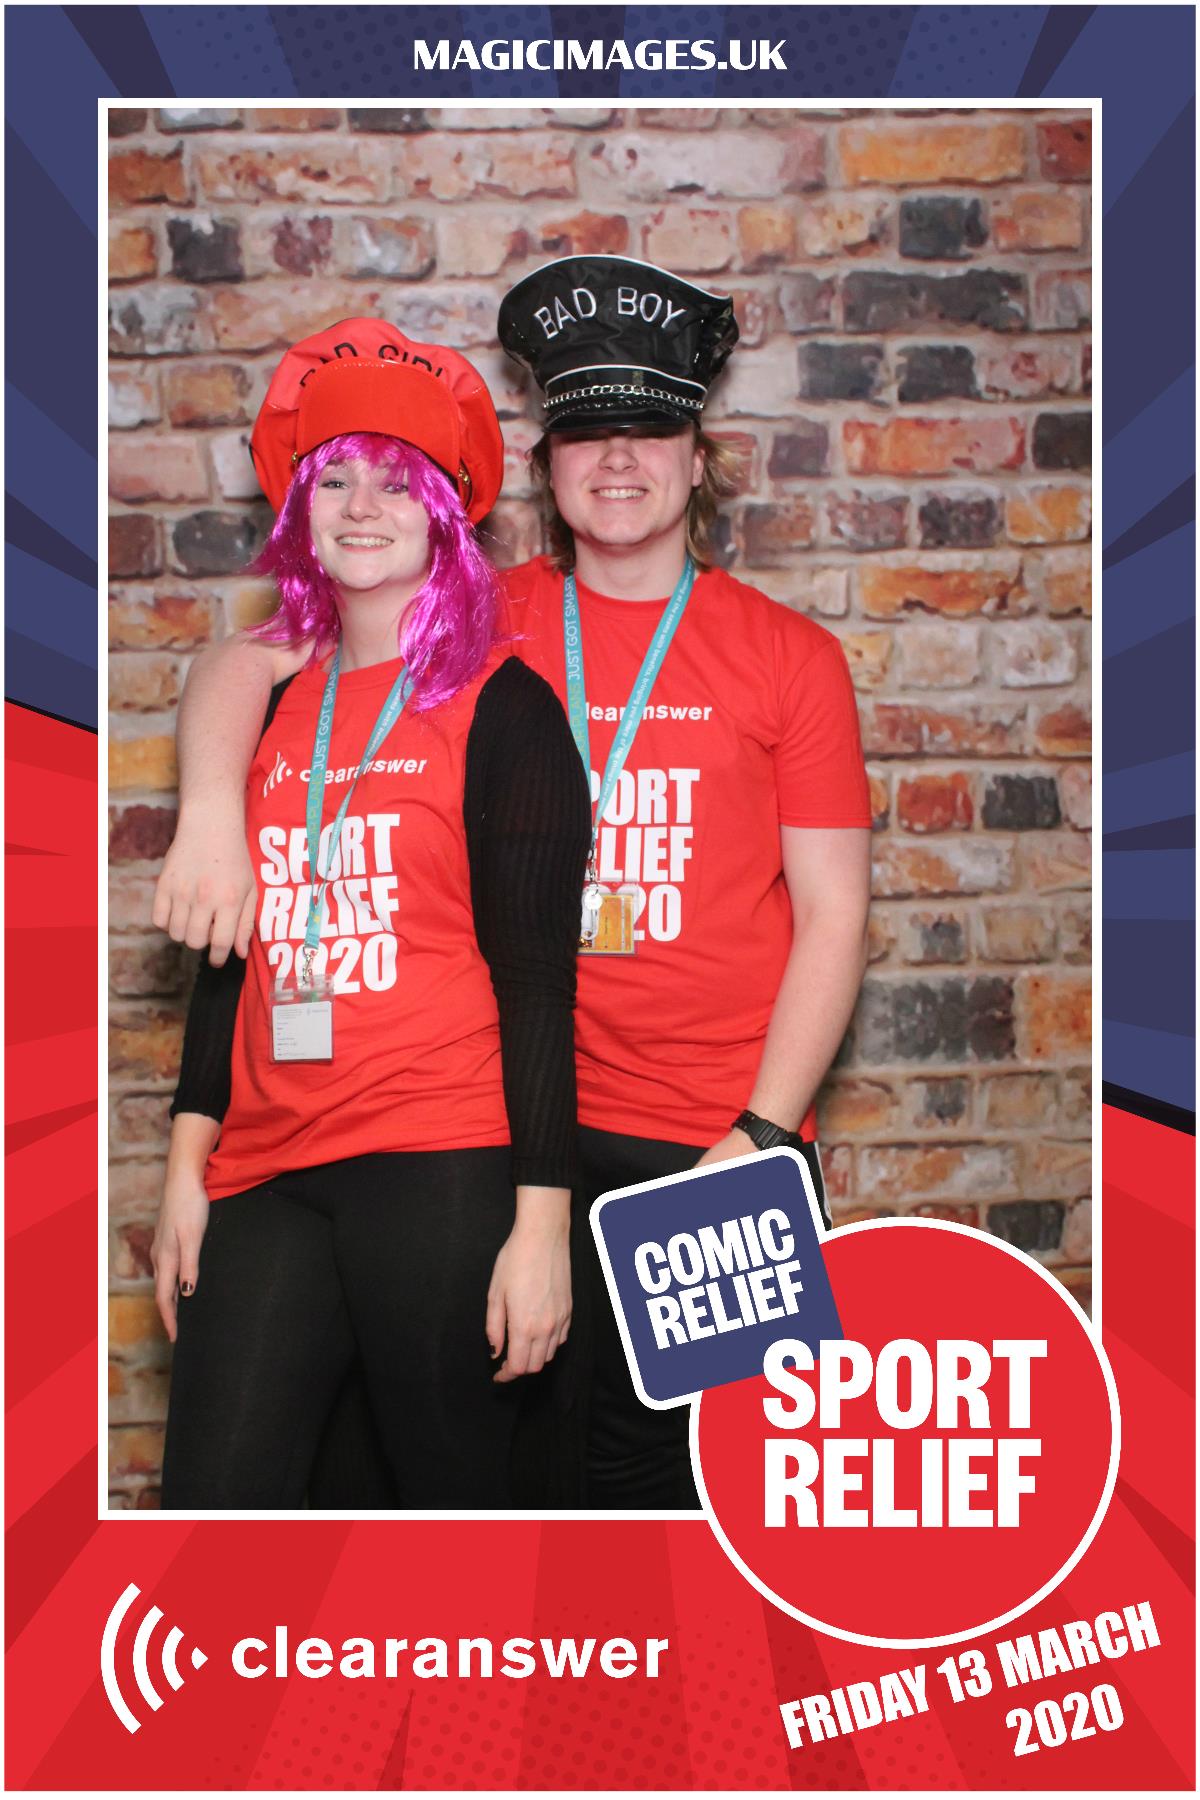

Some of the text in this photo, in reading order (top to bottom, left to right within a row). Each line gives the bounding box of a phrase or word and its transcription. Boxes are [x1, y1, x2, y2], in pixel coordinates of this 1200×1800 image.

[534, 286, 687, 339] BAD BOY
[565, 619, 579, 647] GOT
[567, 647, 581, 680] JUST
[318, 709, 330, 736] GOT
[313, 737, 327, 770] JUST
[259, 814, 400, 886] SPORT
